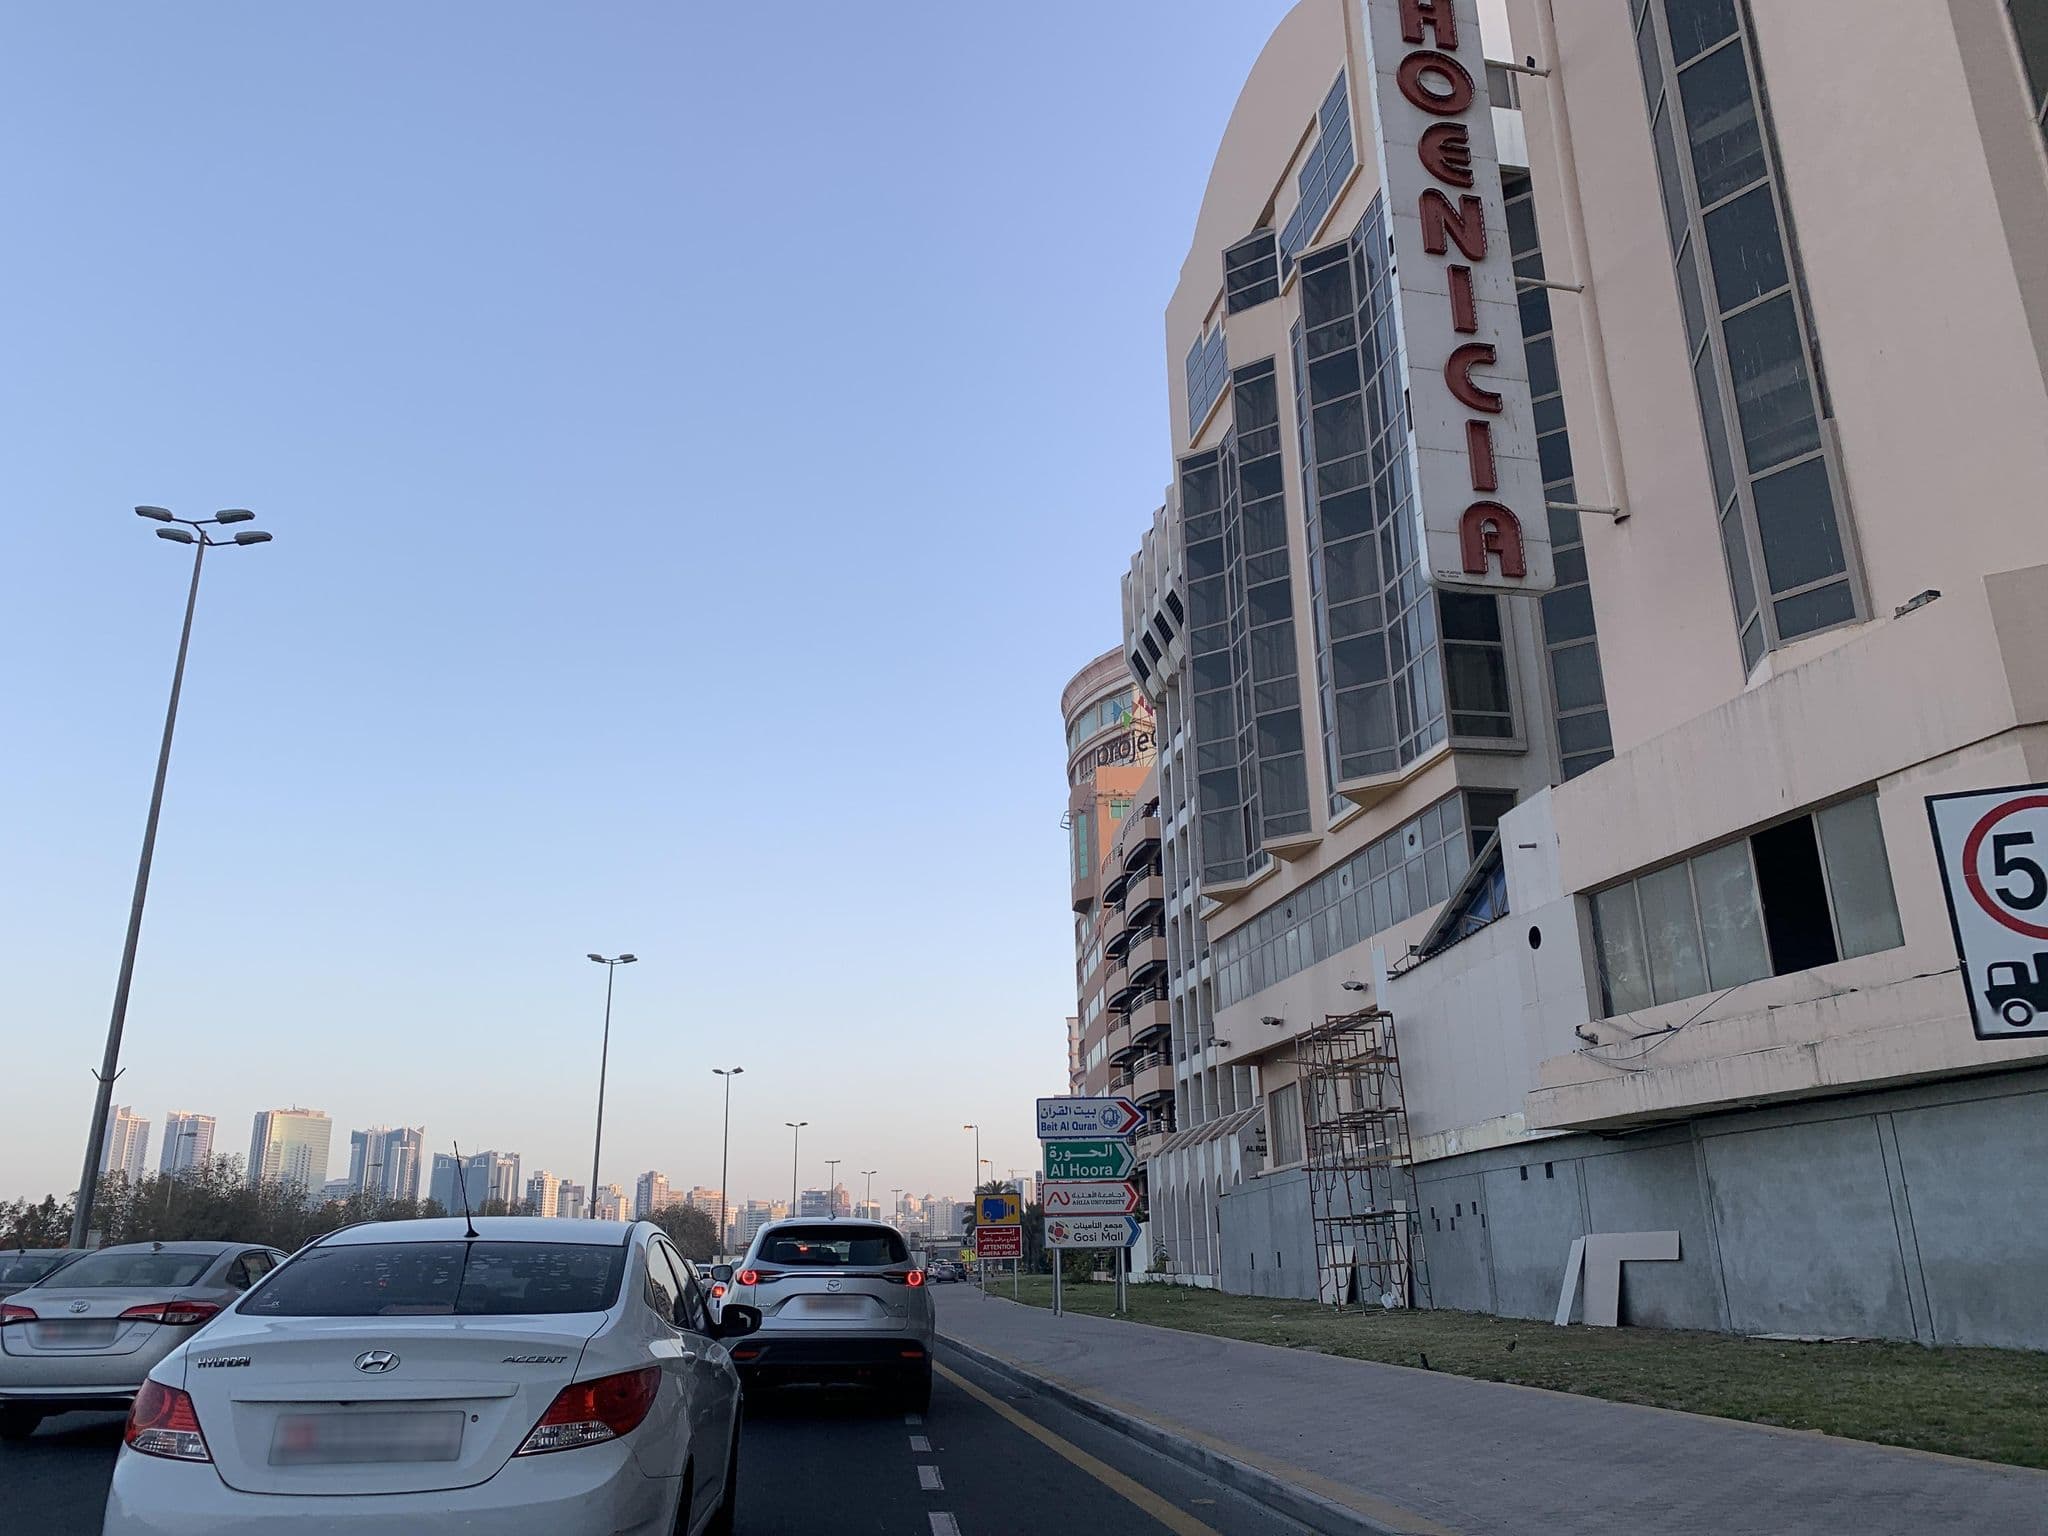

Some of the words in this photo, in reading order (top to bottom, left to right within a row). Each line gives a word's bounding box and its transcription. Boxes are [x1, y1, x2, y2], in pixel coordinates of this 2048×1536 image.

[1073, 1107, 1096, 1118] بيت
[1041, 1122, 1057, 1131] Beit
[1060, 1121, 1069, 1131] Al
[1072, 1121, 1097, 1131] Quran
[1050, 1164, 1064, 1177] Al
[1069, 1163, 1113, 1176] Hoora
[1103, 1222, 1123, 1232] مجمع
[1073, 1232, 1097, 1242] Gosi
[1101, 1231, 1123, 1242] Mall
[197, 1356, 252, 1369] HYUNDAI
[501, 1355, 568, 1364] ACCENT
